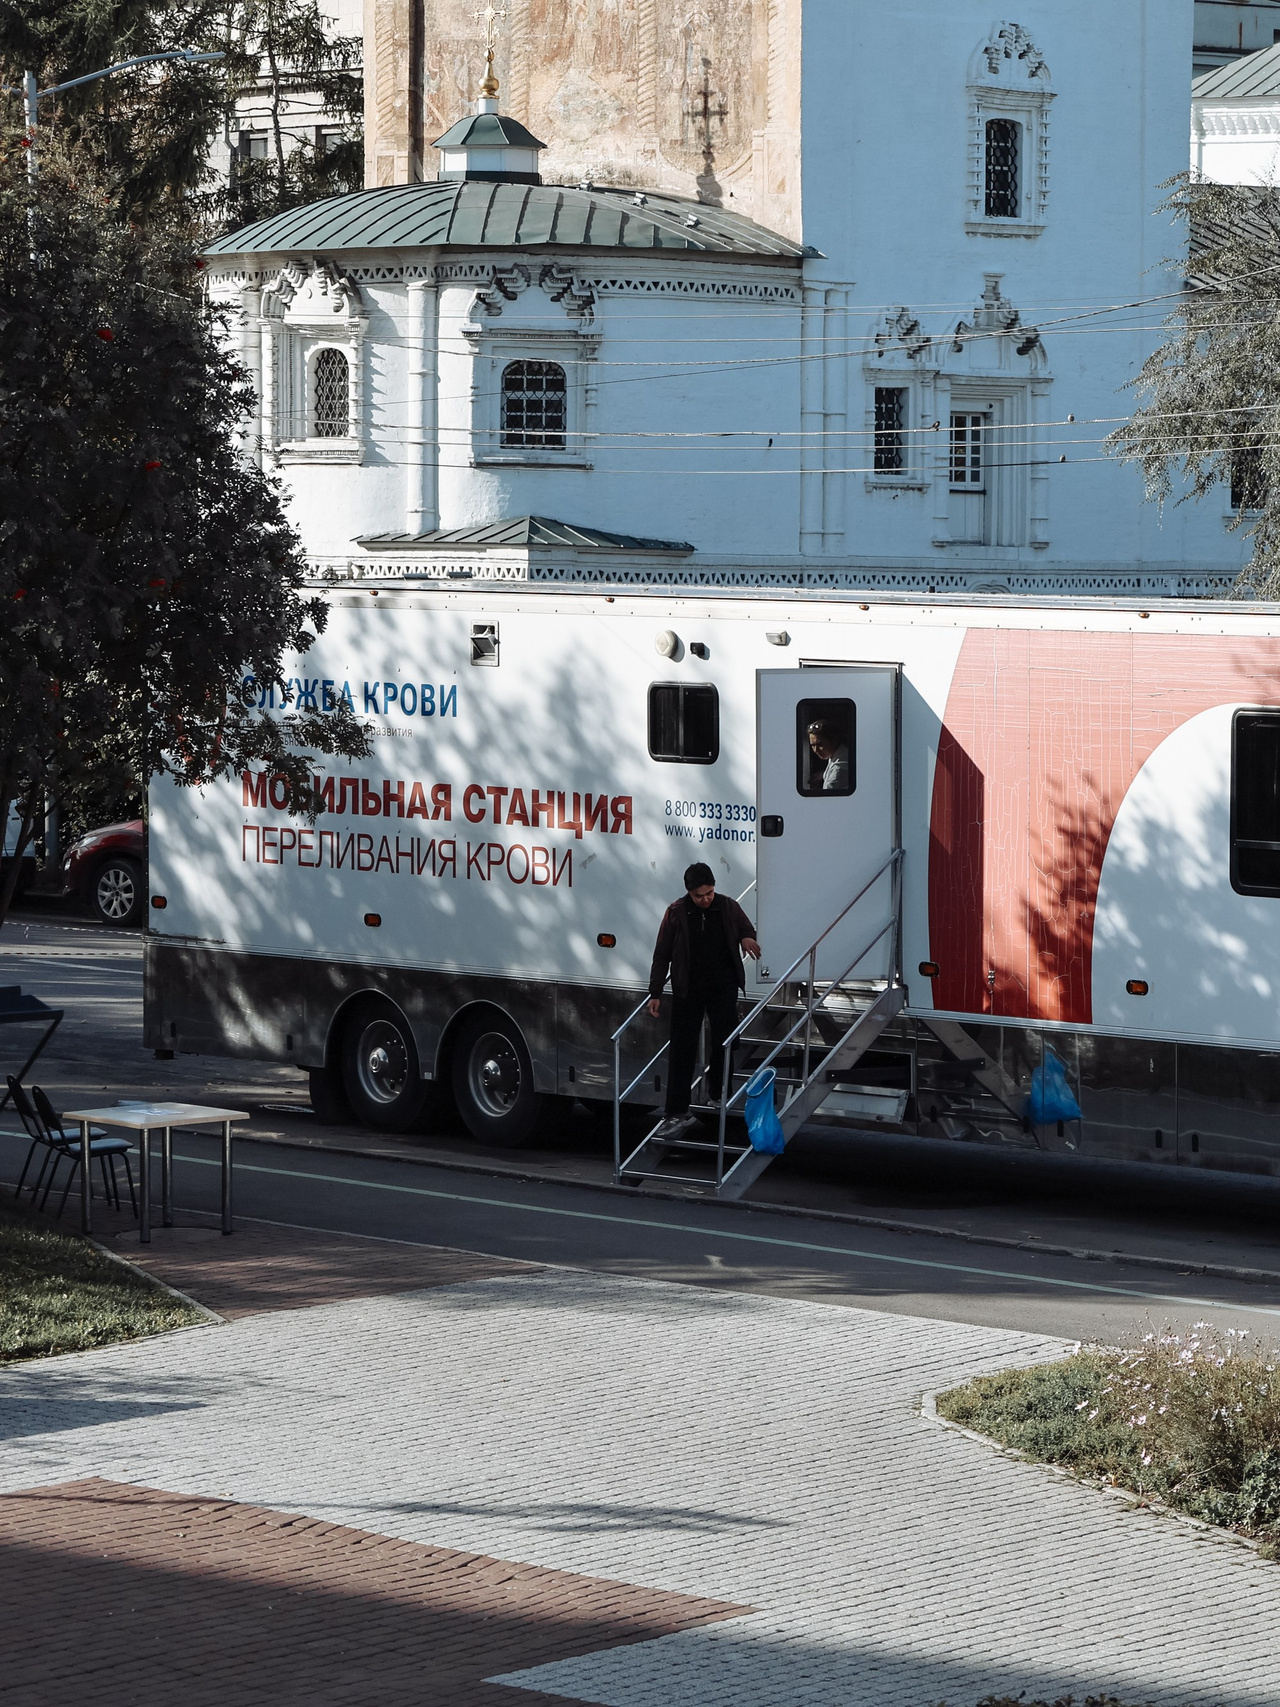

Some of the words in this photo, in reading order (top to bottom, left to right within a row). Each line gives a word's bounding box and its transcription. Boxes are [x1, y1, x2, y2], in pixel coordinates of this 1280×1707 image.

[364, 681, 458, 718] КРОВИ
[462, 783, 633, 840] СТАНЦИЯ
[665, 799, 673, 816] 8
[675, 800, 697, 818] 800
[699, 802, 723, 820] 333
[725, 804, 757, 822] 3330
[242, 824, 457, 879] ПЕРЕЛИВАНИЯ
[466, 841, 573, 888] КРОВИ
